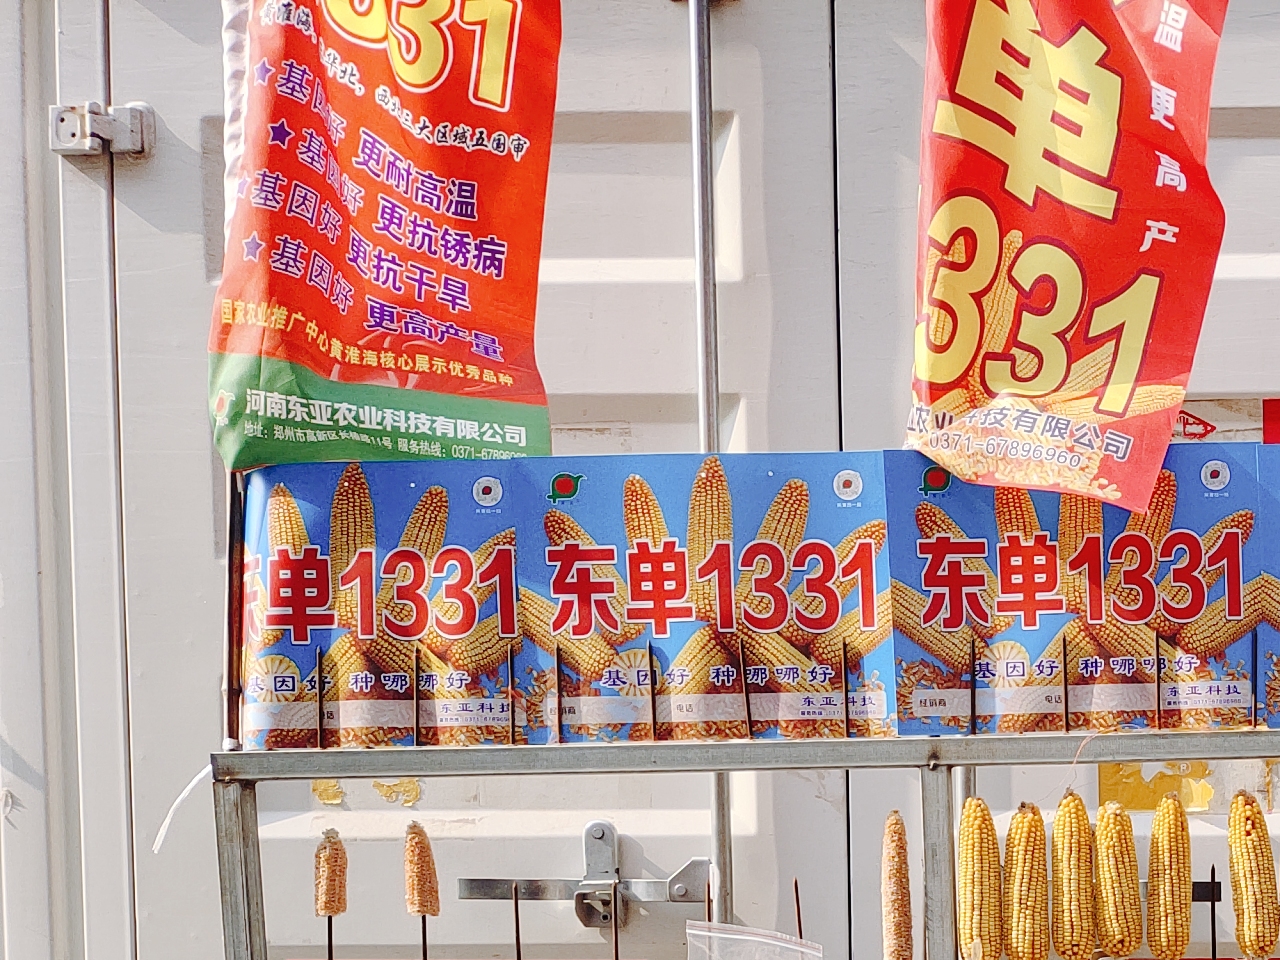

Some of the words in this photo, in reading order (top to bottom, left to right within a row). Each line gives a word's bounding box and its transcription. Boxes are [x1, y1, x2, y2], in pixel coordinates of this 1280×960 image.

[932, 0, 1125, 221] 单
[298, 127, 364, 214] 基因好
[375, 195, 508, 278] 更抗锈病
[354, 128, 478, 221] 更耐高温
[251, 170, 343, 245] 基因好
[347, 227, 472, 313] 更抗干旱
[221, 298, 514, 387] 国家农业推广中心黄淮海核心展示优秀品种
[271, 235, 355, 315] 基因好
[365, 295, 505, 361] 更高产量
[914, 189, 1165, 418] 331
[245, 388, 527, 447] 河南东亚农业科技有限公司
[929, 432, 1081, 468] 0371-67896960
[544, 536, 880, 639] 东单1331
[916, 527, 1247, 631] 东单1331
[247, 673, 331, 697] 基因好
[350, 670, 471, 694] 种哪哪好
[601, 665, 690, 688] 基因好
[710, 664, 834, 687] 种哪哪好
[974, 657, 1060, 680] 基因好
[1079, 653, 1201, 678] 种哪哪好
[1166, 685, 1242, 697] 东亚科技
